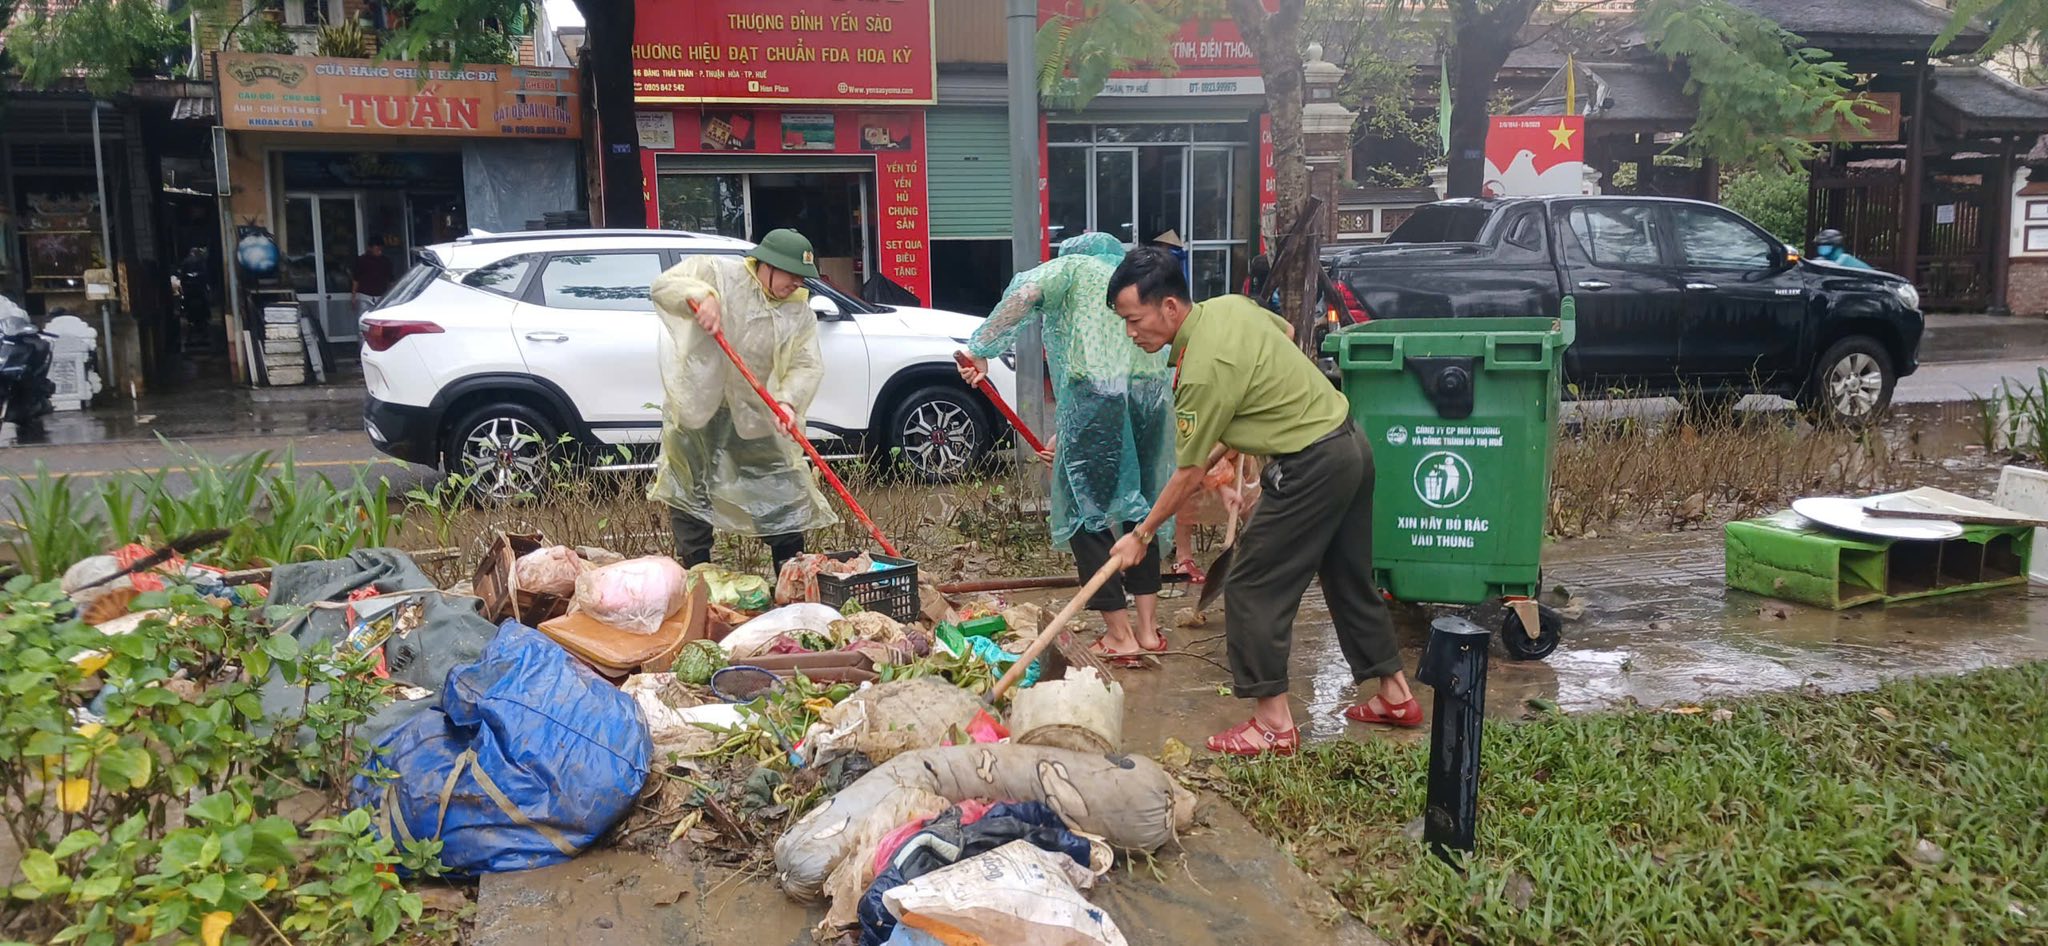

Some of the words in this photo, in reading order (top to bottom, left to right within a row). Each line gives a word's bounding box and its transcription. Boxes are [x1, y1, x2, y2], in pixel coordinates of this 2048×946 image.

[728, 13, 784, 32] THƯỢNG
[791, 10, 823, 31] ĐỈNH
[831, 10, 858, 32] YẾN
[866, 13, 892, 32] SÀO
[631, 43, 682, 60] HƯƠNG
[689, 42, 720, 63] HIỆU
[729, 46, 758, 63] ĐẠT
[767, 38, 815, 61] CHUẨN
[822, 48, 849, 62] FDA
[858, 48, 886, 63] HOA
[893, 45, 912, 63] KỲ
[1200, 38, 1221, 61] ĐIỆN
[315, 63, 344, 76] CỬA
[339, 83, 480, 131] TUẤN
[886, 160, 903, 173] YẾN
[894, 177, 911, 188] YẾN
[886, 240, 902, 249] SET
[1446, 427, 1456, 435] CP
[1398, 516, 1417, 529] XIN
[1420, 515, 1442, 530] HÃY
[1446, 514, 1461, 531] BỎ
[1464, 516, 1489, 531] RÁC
[1411, 533, 1433, 546] VÀO
[1436, 533, 1474, 548] THÙNG
